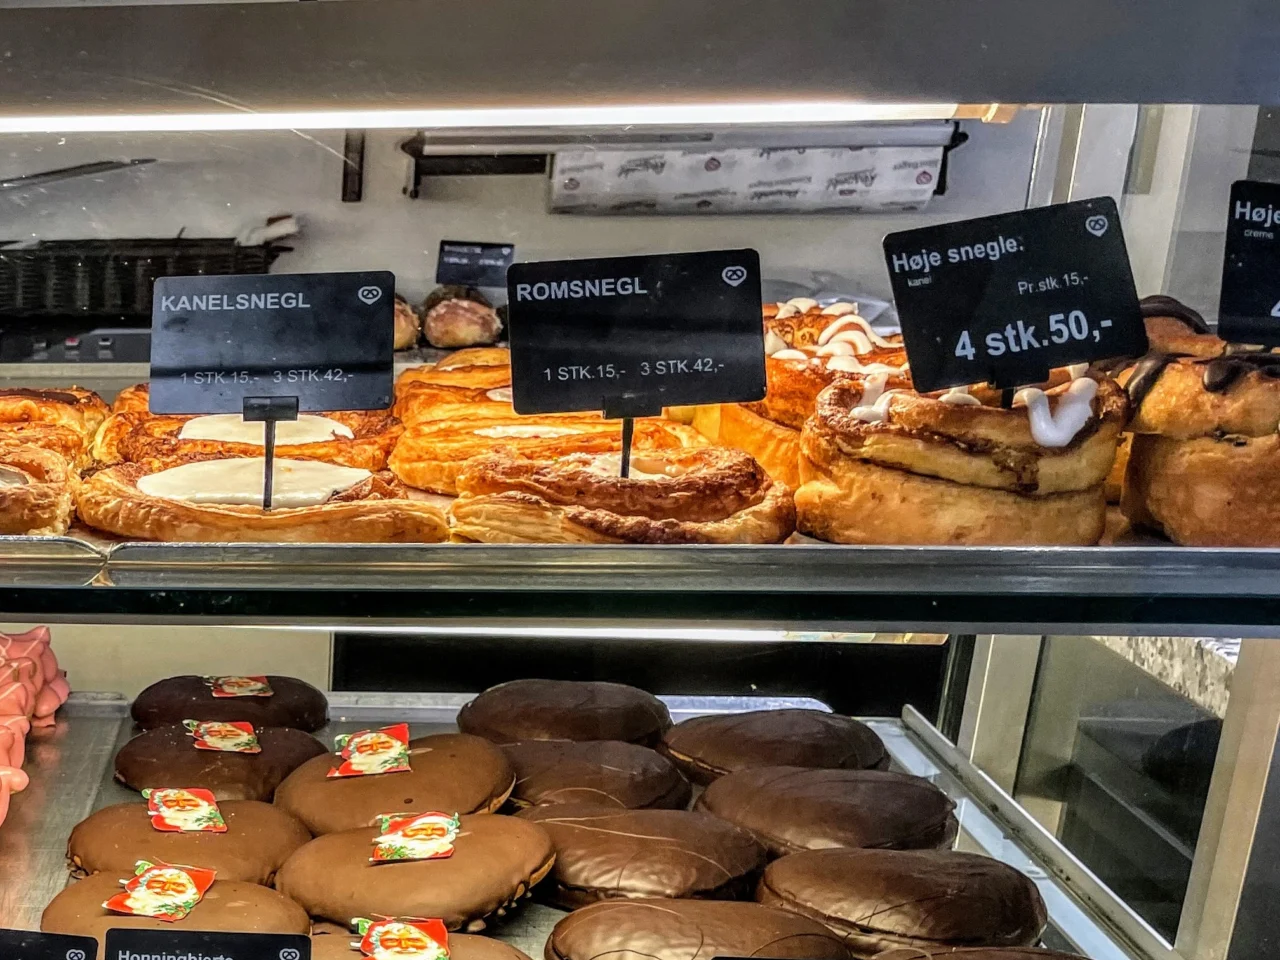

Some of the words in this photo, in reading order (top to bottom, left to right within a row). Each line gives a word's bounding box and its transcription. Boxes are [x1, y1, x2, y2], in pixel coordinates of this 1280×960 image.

[892, 252, 942, 274] Høje
[516, 277, 648, 302] ROMSNEGL
[907, 276, 932, 288] kanel
[161, 292, 311, 312] KANELSNEGL
[954, 330, 976, 360] 4
[985, 310, 1113, 356] stk.50,-
[180, 373, 188, 385] 1
[194, 371, 259, 385] STK.15,-
[273, 370, 282, 383] 3
[287, 368, 354, 384] STK.42,-
[543, 368, 552, 381] 1
[557, 364, 626, 381] STK.15,-
[640, 362, 650, 376] 3
[655, 358, 724, 375] STK.42,-
